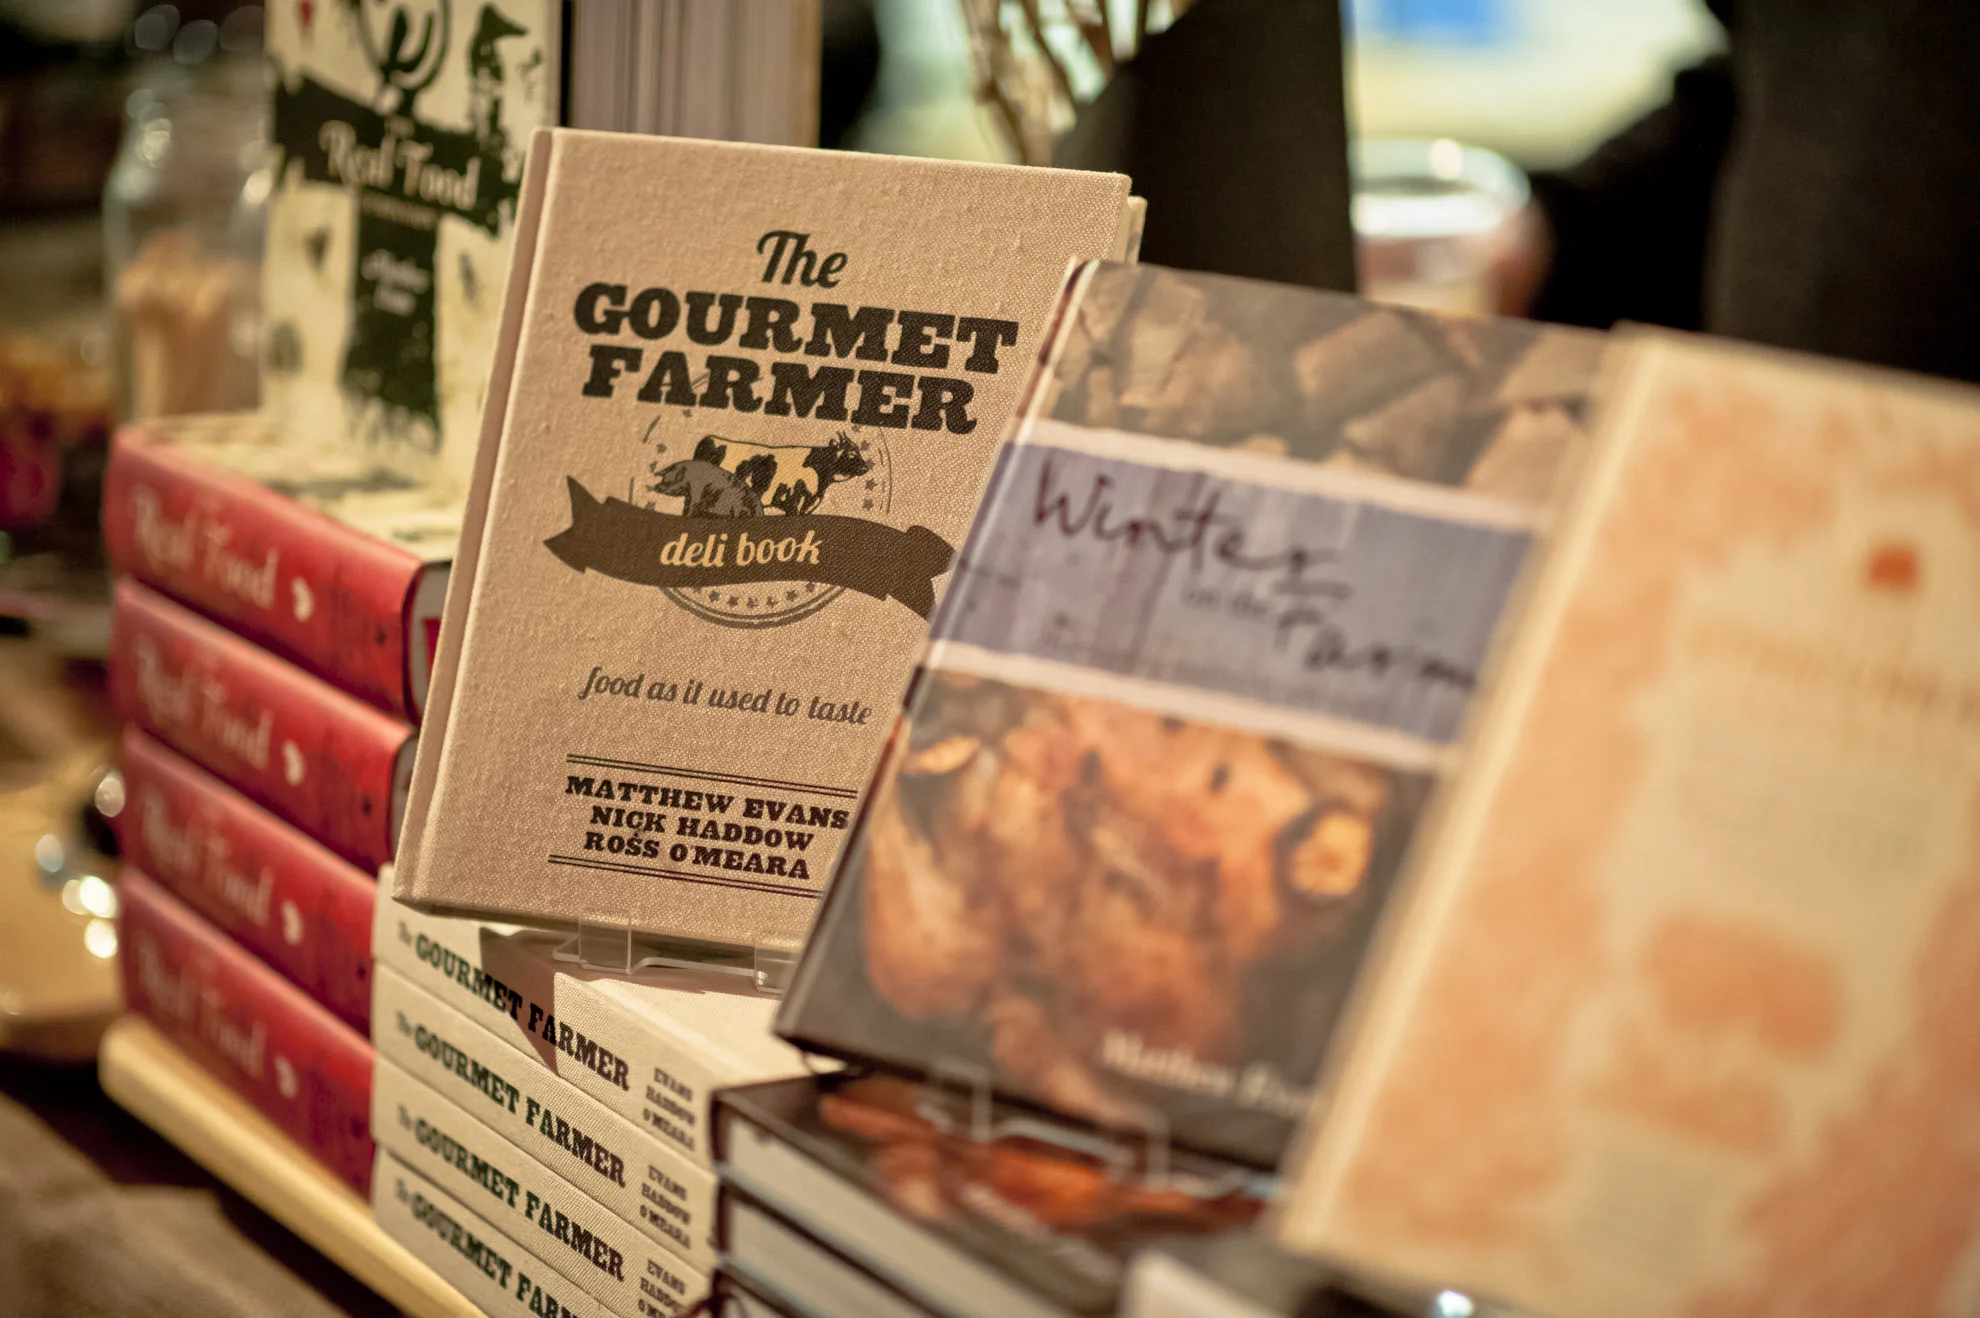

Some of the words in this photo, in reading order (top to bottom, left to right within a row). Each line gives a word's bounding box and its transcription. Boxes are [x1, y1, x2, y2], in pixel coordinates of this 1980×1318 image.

[756, 229, 848, 288] The
[573, 282, 1019, 375] GOURMET
[581, 344, 978, 435] FARMER
[660, 532, 728, 568] deli
[736, 530, 823, 566] book
[1033, 457, 1345, 582] Winter
[578, 666, 645, 700] food
[646, 679, 678, 702] as
[683, 679, 704, 705] it
[708, 689, 772, 713] used
[775, 691, 800, 716] to
[807, 696, 873, 725] taste
[565, 775, 735, 815] MATTHEW
[743, 797, 850, 830] EVANS
[589, 805, 667, 834] NICK
[676, 816, 815, 853] HADDOW
[583, 831, 660, 859] ROSS
[669, 842, 811, 880] O'MEARA
[415, 933, 523, 1021] GOURMET
[527, 1002, 630, 1092] FARMER
[414, 1024, 521, 1112] GOURMET
[525, 1096, 626, 1189] FARMER
[653, 1067, 693, 1101] EVANS
[414, 1118, 520, 1208] GOURMET
[524, 1190, 625, 1282] FARMER
[647, 1164, 688, 1201] EVANS
[411, 1192, 513, 1289] GOURMET
[640, 1277, 678, 1312] HADD
[647, 1259, 686, 1296] EVANS
